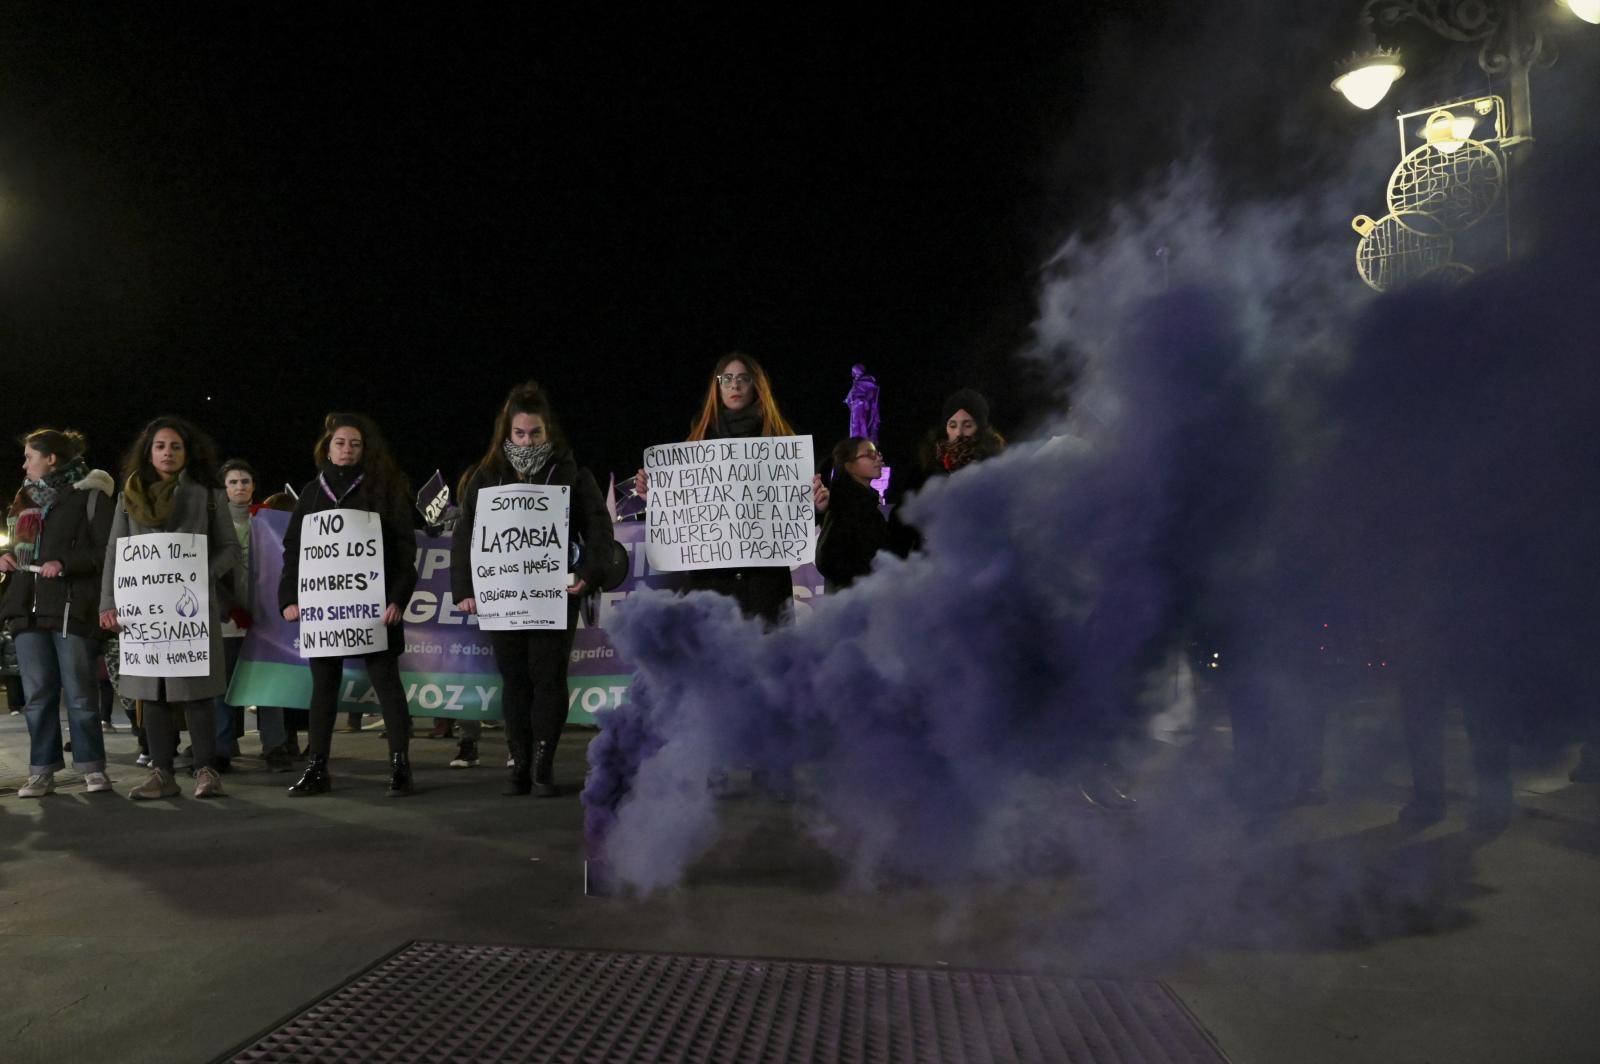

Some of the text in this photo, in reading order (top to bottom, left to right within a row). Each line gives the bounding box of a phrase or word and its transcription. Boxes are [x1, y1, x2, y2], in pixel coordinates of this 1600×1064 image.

[720, 443, 739, 461] DE
[744, 442, 770, 461] LOS
[774, 441, 804, 460] QUE
[649, 460, 799, 489] HOY ESTÁN AQUÍ VAN
[651, 484, 812, 508] A EMPEZAR A SOLTAR
[650, 503, 814, 527] LA MIERDA QUE A LAS
[481, 526, 502, 553] LA
[650, 521, 808, 545] MUJERES NOS HAN
[123, 543, 161, 562] CADA
[167, 542, 181, 559] 10
[304, 539, 377, 560] TODOS LOS
[680, 541, 732, 564] HECHO
[739, 540, 807, 562] PASAR?
[476, 566, 496, 578] QUE
[499, 563, 520, 575] NOS
[118, 575, 138, 589] UNA
[142, 573, 185, 586] MUJER
[520, 590, 529, 601] A
[149, 604, 164, 615] ES
[300, 603, 381, 623] PERO SIEMPRE
[303, 631, 316, 650] UN
[319, 628, 374, 649] HOMBRE
[404, 641, 443, 655] ución
[449, 642, 494, 656] #abol
[124, 650, 208, 665] POR UN HOMBRE
[342, 680, 381, 705] LA
[475, 685, 499, 711] Y
[568, 686, 628, 713] OT
